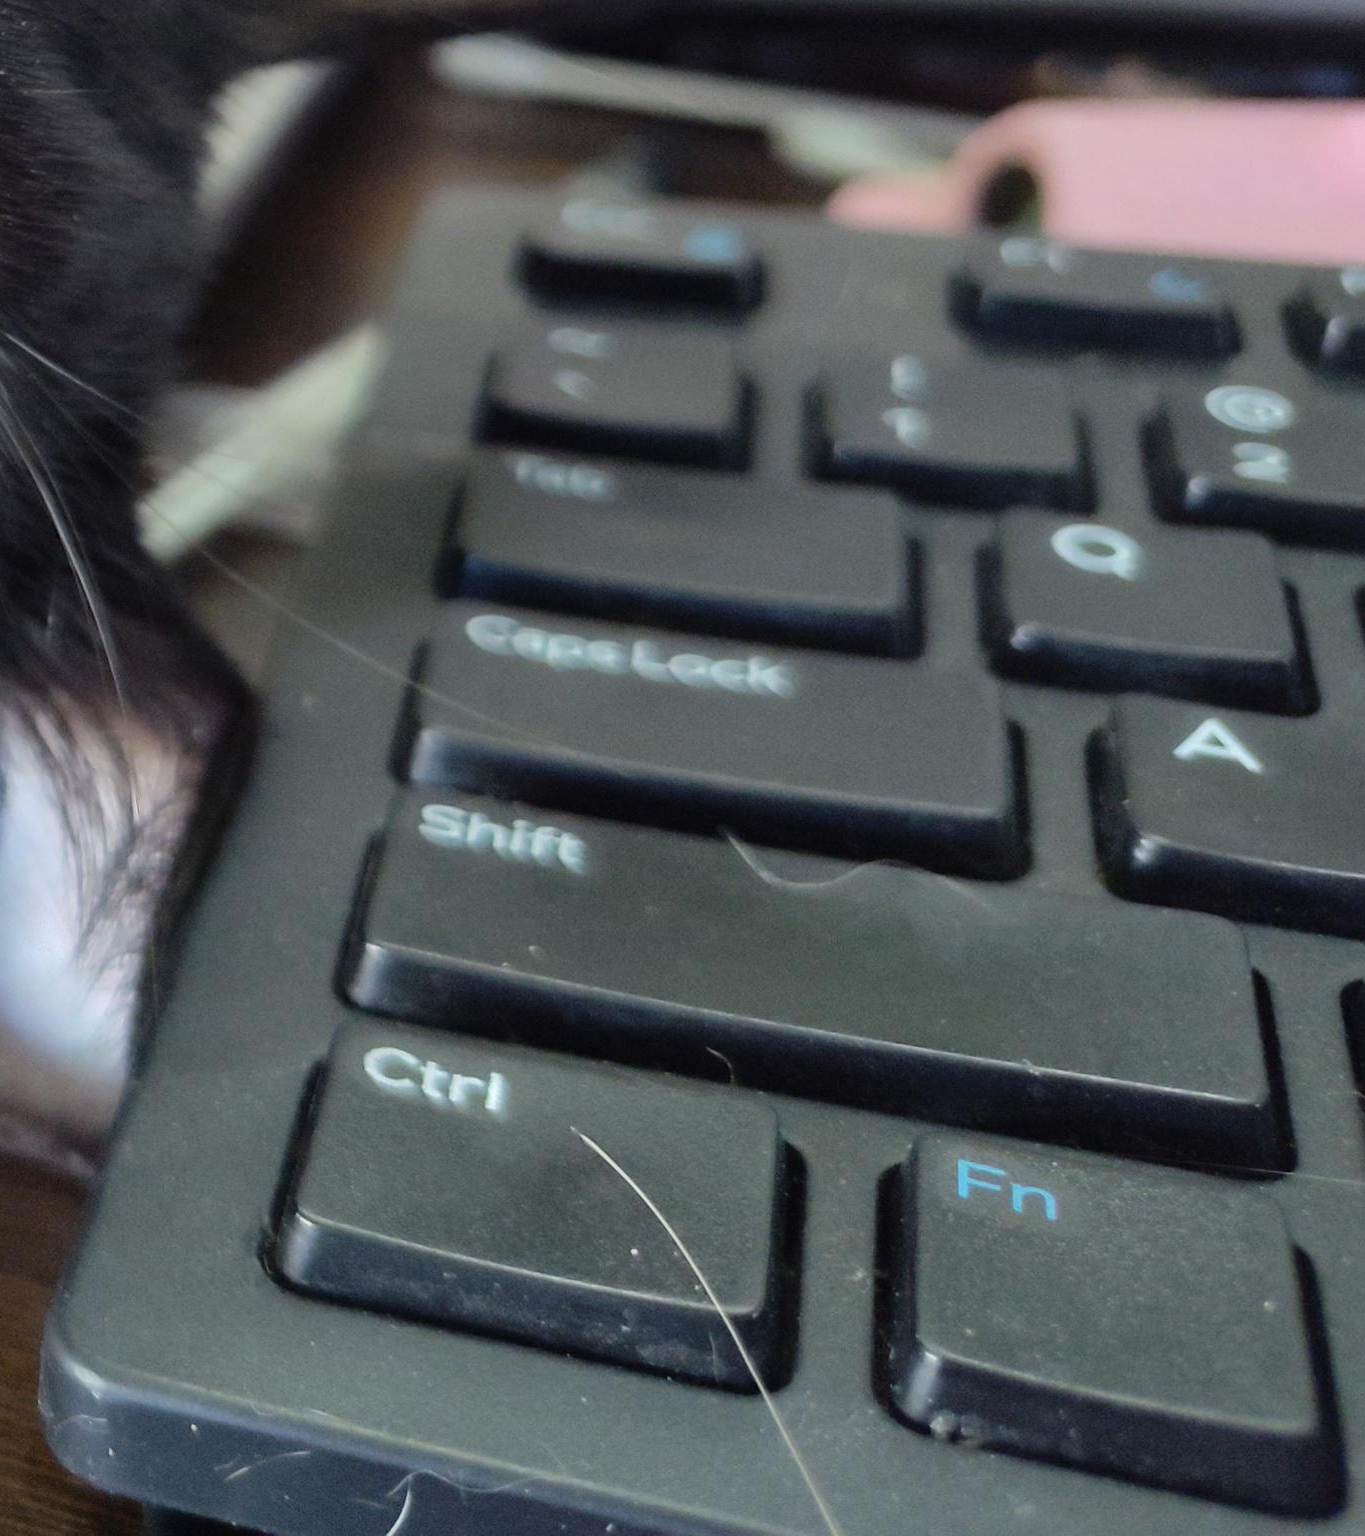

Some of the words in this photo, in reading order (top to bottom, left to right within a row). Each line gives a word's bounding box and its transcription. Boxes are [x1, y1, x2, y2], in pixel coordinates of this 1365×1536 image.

[1051, 523, 1142, 581] Q
[1173, 718, 1264, 774] A
[419, 804, 587, 875] Shift
[364, 1047, 507, 1114] Ctrl
[957, 1159, 1057, 1221] Fn
